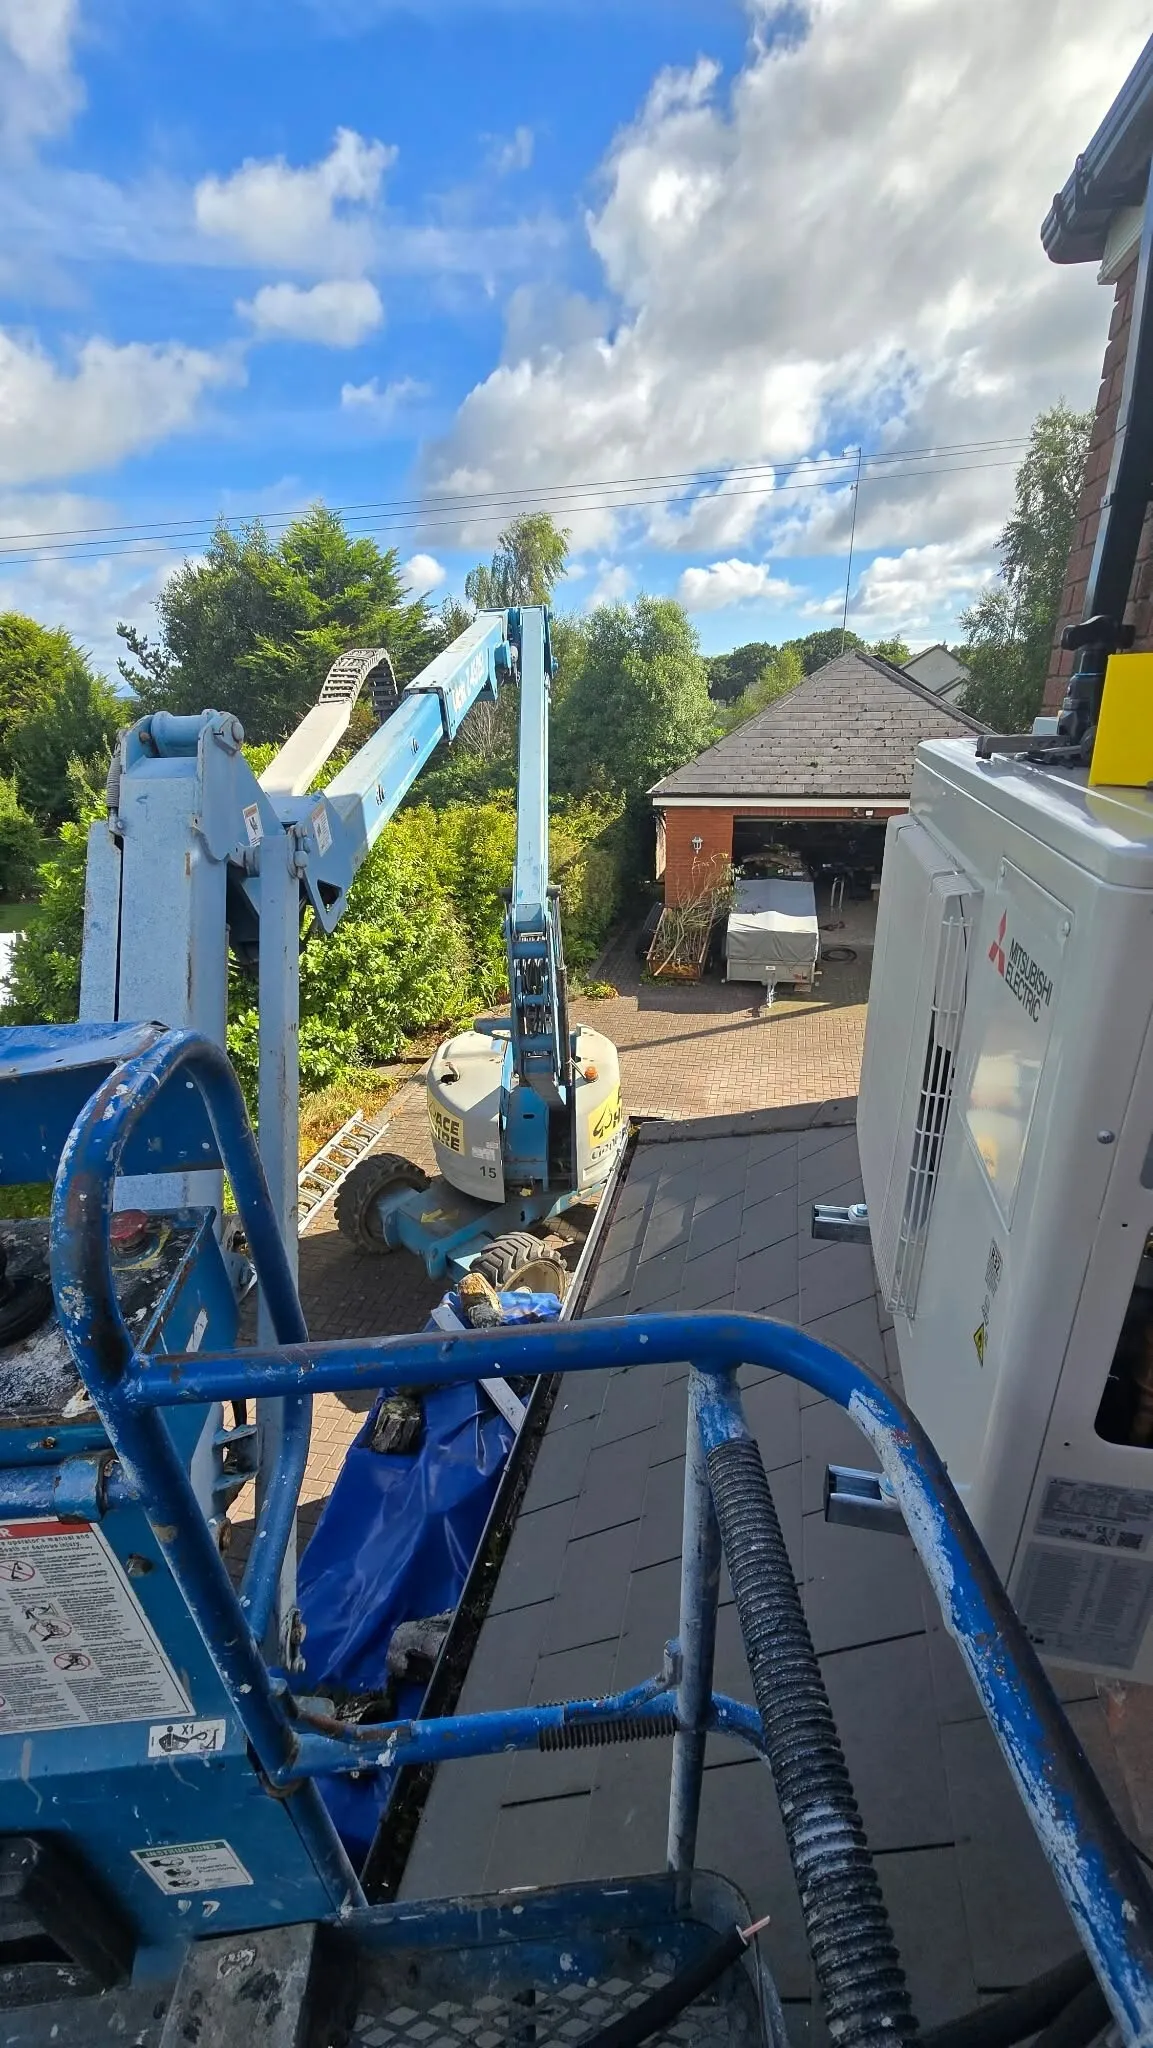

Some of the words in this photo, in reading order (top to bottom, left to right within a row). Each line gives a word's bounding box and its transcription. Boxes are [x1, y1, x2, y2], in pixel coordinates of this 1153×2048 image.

[1009, 937, 1053, 1006] MITSUBISHI
[1005, 962, 1041, 1022] ELECTRIC
[480, 1166, 496, 1179] 15
[182, 1724, 194, 1735] X1
[145, 1843, 217, 1857] INSTRUCTIONS
